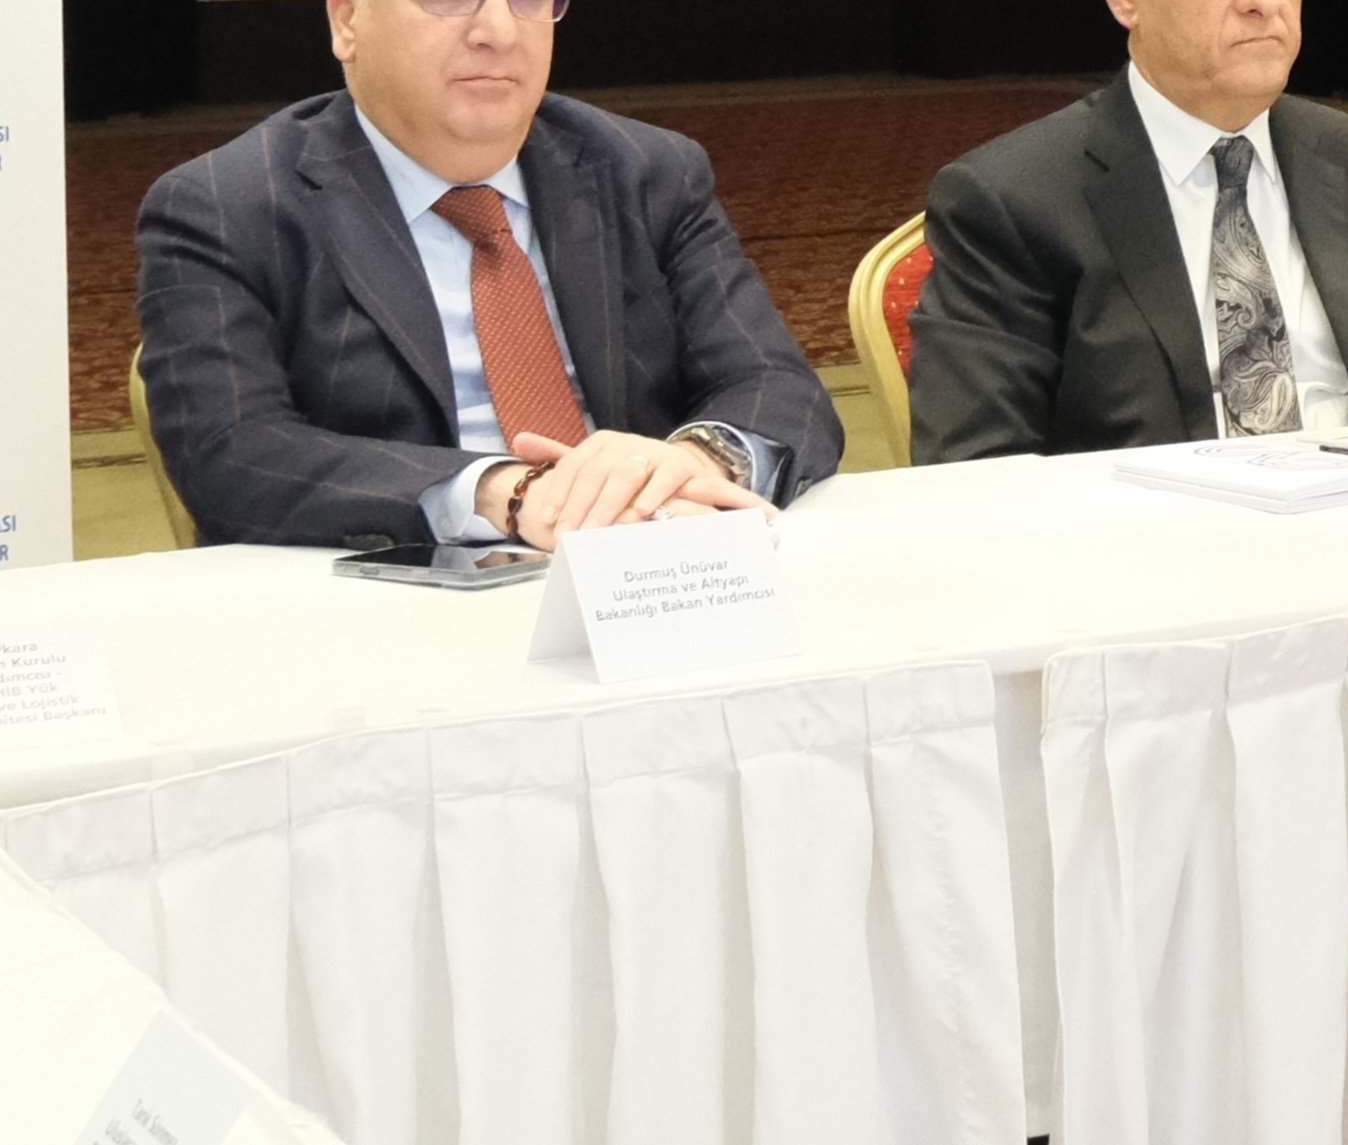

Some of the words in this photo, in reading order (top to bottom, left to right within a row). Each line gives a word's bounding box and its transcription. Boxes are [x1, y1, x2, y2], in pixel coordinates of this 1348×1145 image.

[624, 567, 677, 583] Durmuş
[680, 560, 729, 575] Ünüvar
[612, 585, 678, 601] Ulaştırma
[681, 581, 697, 592] ve
[701, 575, 749, 590] Altyapı
[706, 587, 775, 606] Yardımcısı
[0, 643, 38, 654] kara
[11, 654, 66, 668] Kurulu
[0, 711, 38, 725] itesi
